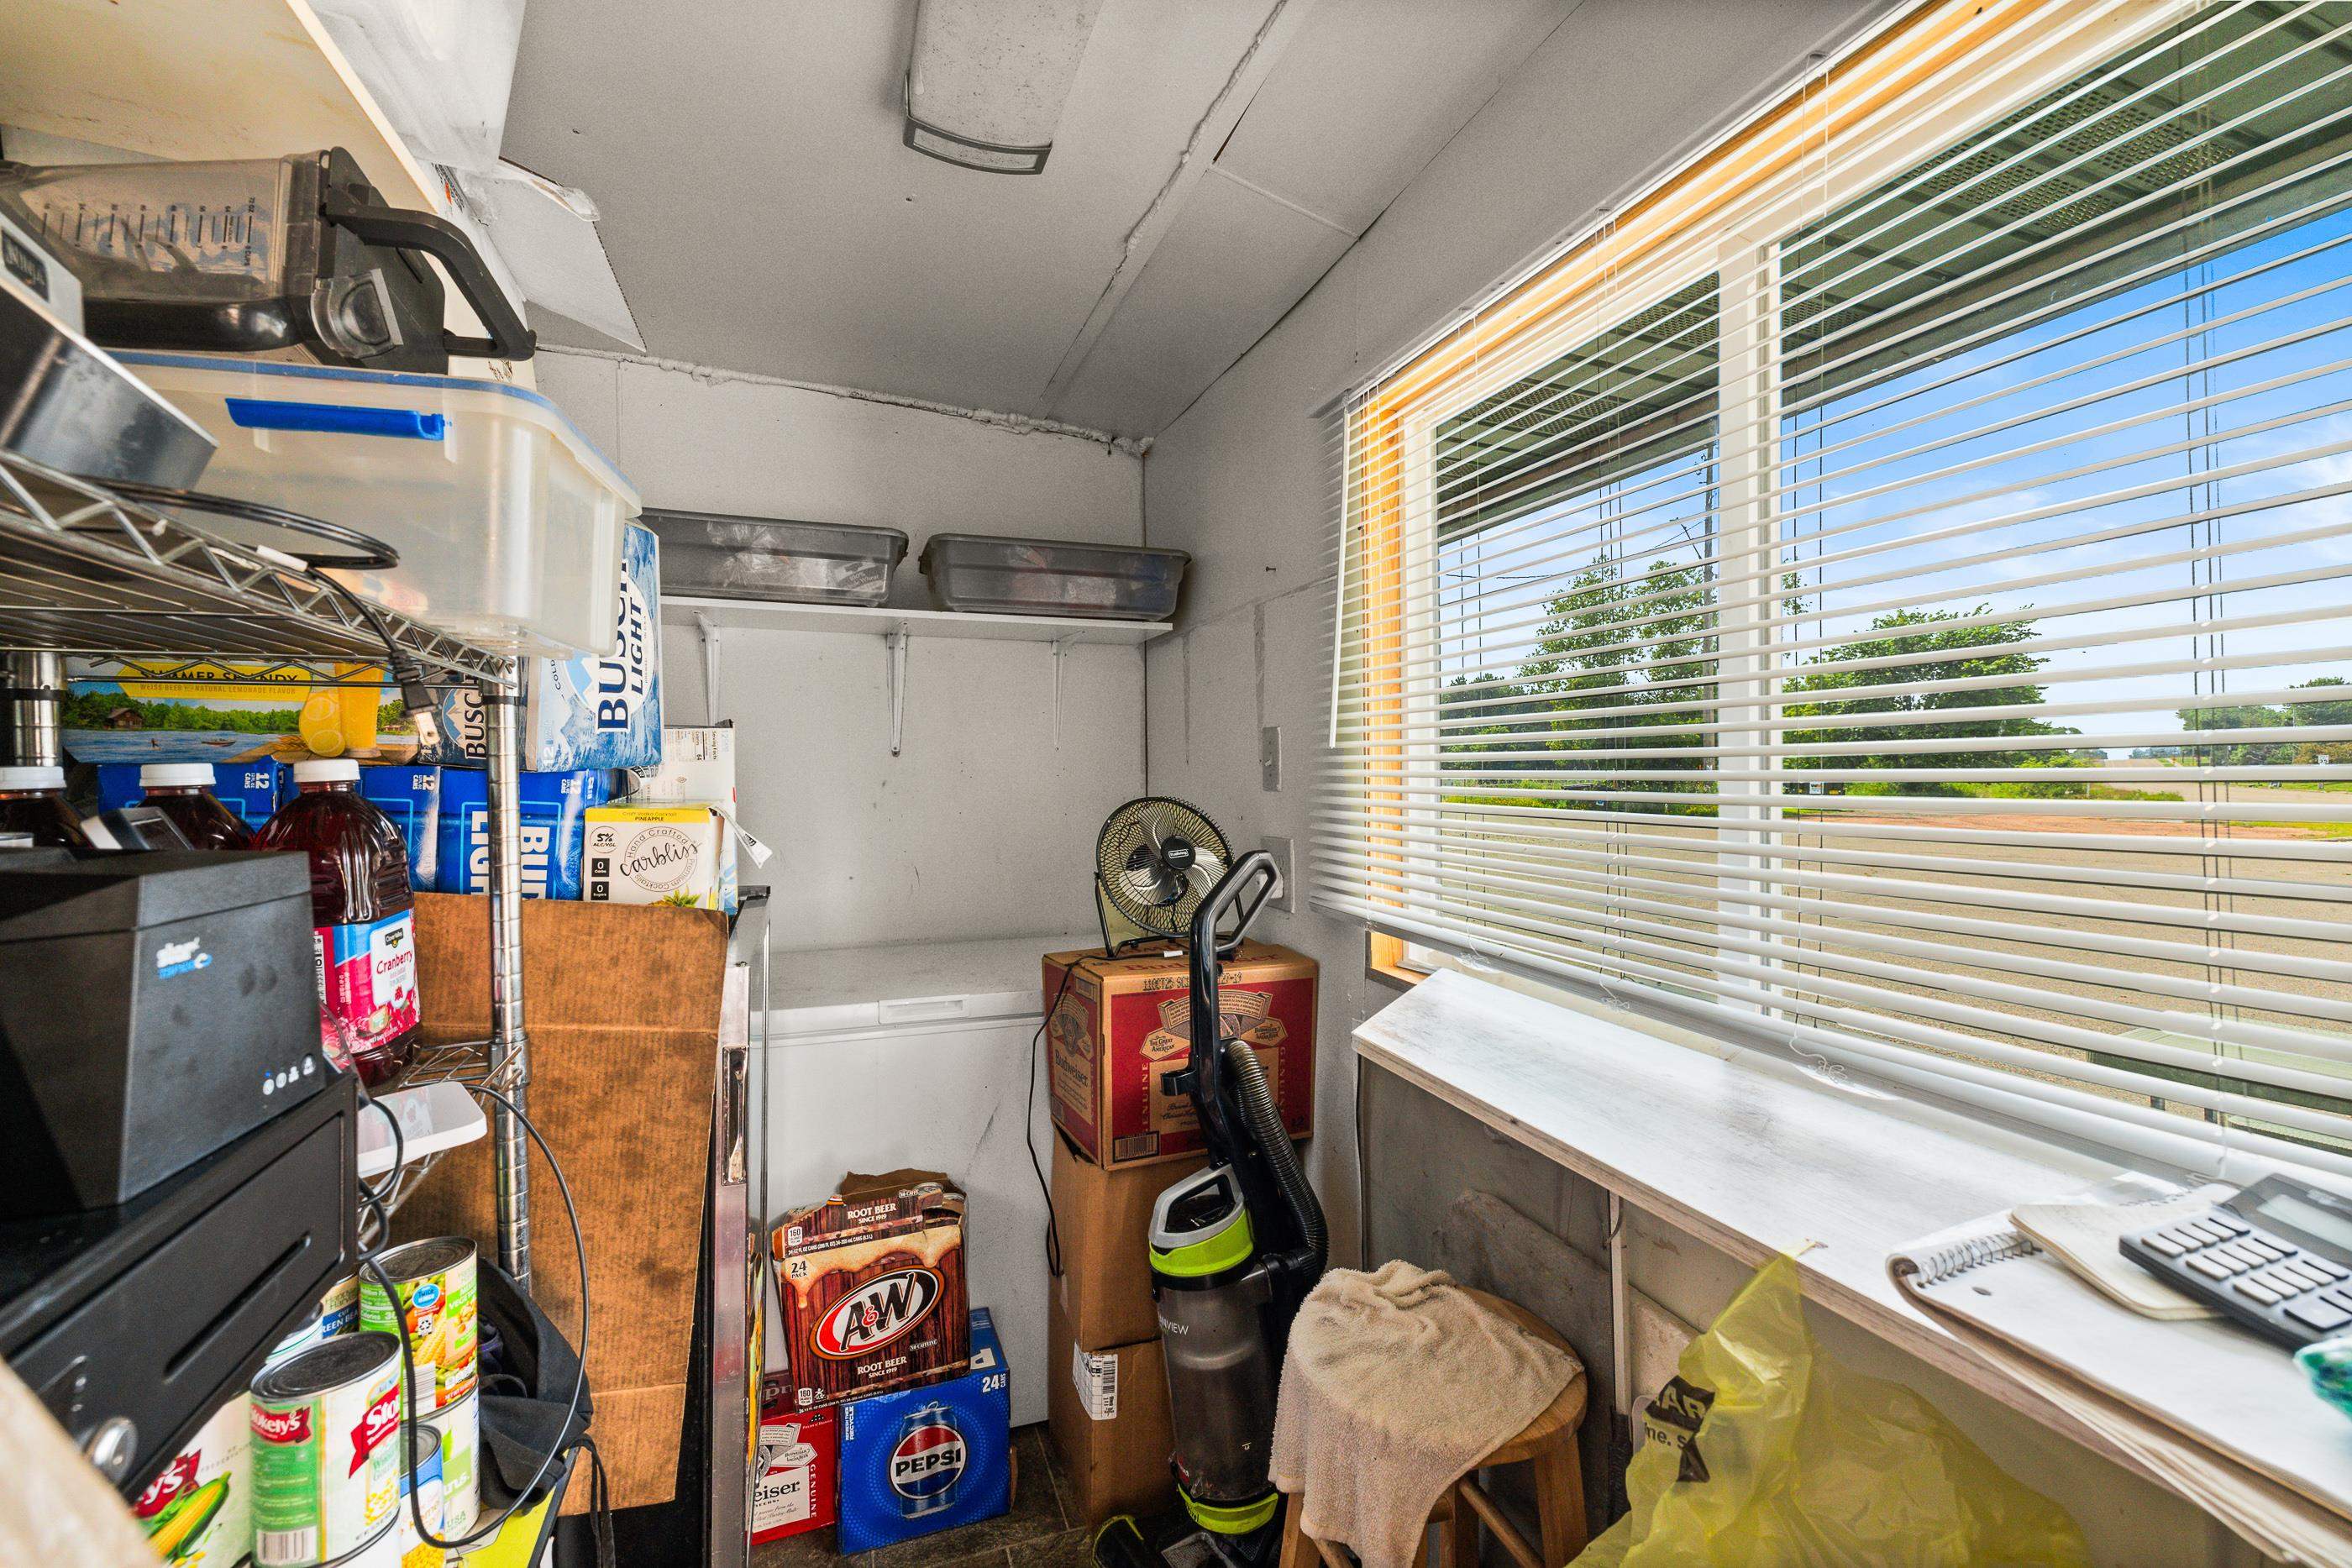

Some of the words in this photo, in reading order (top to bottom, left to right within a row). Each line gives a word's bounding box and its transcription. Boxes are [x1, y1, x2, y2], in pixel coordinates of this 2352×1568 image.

[630, 597, 643, 695] LIGHT
[549, 659, 561, 690] COLD
[255, 773, 269, 789] 12
[423, 774, 435, 790] 12
[596, 833, 614, 842] 5%
[627, 834, 646, 858] Hand
[648, 828, 689, 845] Crafted
[520, 826, 549, 899] BUD
[597, 862, 604, 870] 0
[376, 950, 413, 974] Cranberry
[1152, 1043, 1175, 1053] AMERICAN
[1055, 1049, 1089, 1088] Budweiser
[847, 1206, 874, 1219] ROOT
[874, 1203, 897, 1214] BEER
[858, 1216, 874, 1225] SINCE
[790, 1228, 801, 1236] 160
[791, 1261, 806, 1273] 24
[840, 1272, 916, 1351] A&W
[323, 1319, 344, 1333] REEN
[1158, 1313, 1189, 1335] NVIEW
[916, 1340, 937, 1349] CAFFEINE
[857, 1362, 884, 1376] ROOT
[885, 1356, 907, 1368] BEER
[869, 1371, 885, 1379] SINCE
[983, 1374, 1000, 1392] 24
[1655, 1386, 1706, 1419] AR
[895, 1446, 962, 1476] PEPSI
[754, 1481, 800, 1502] eiser
